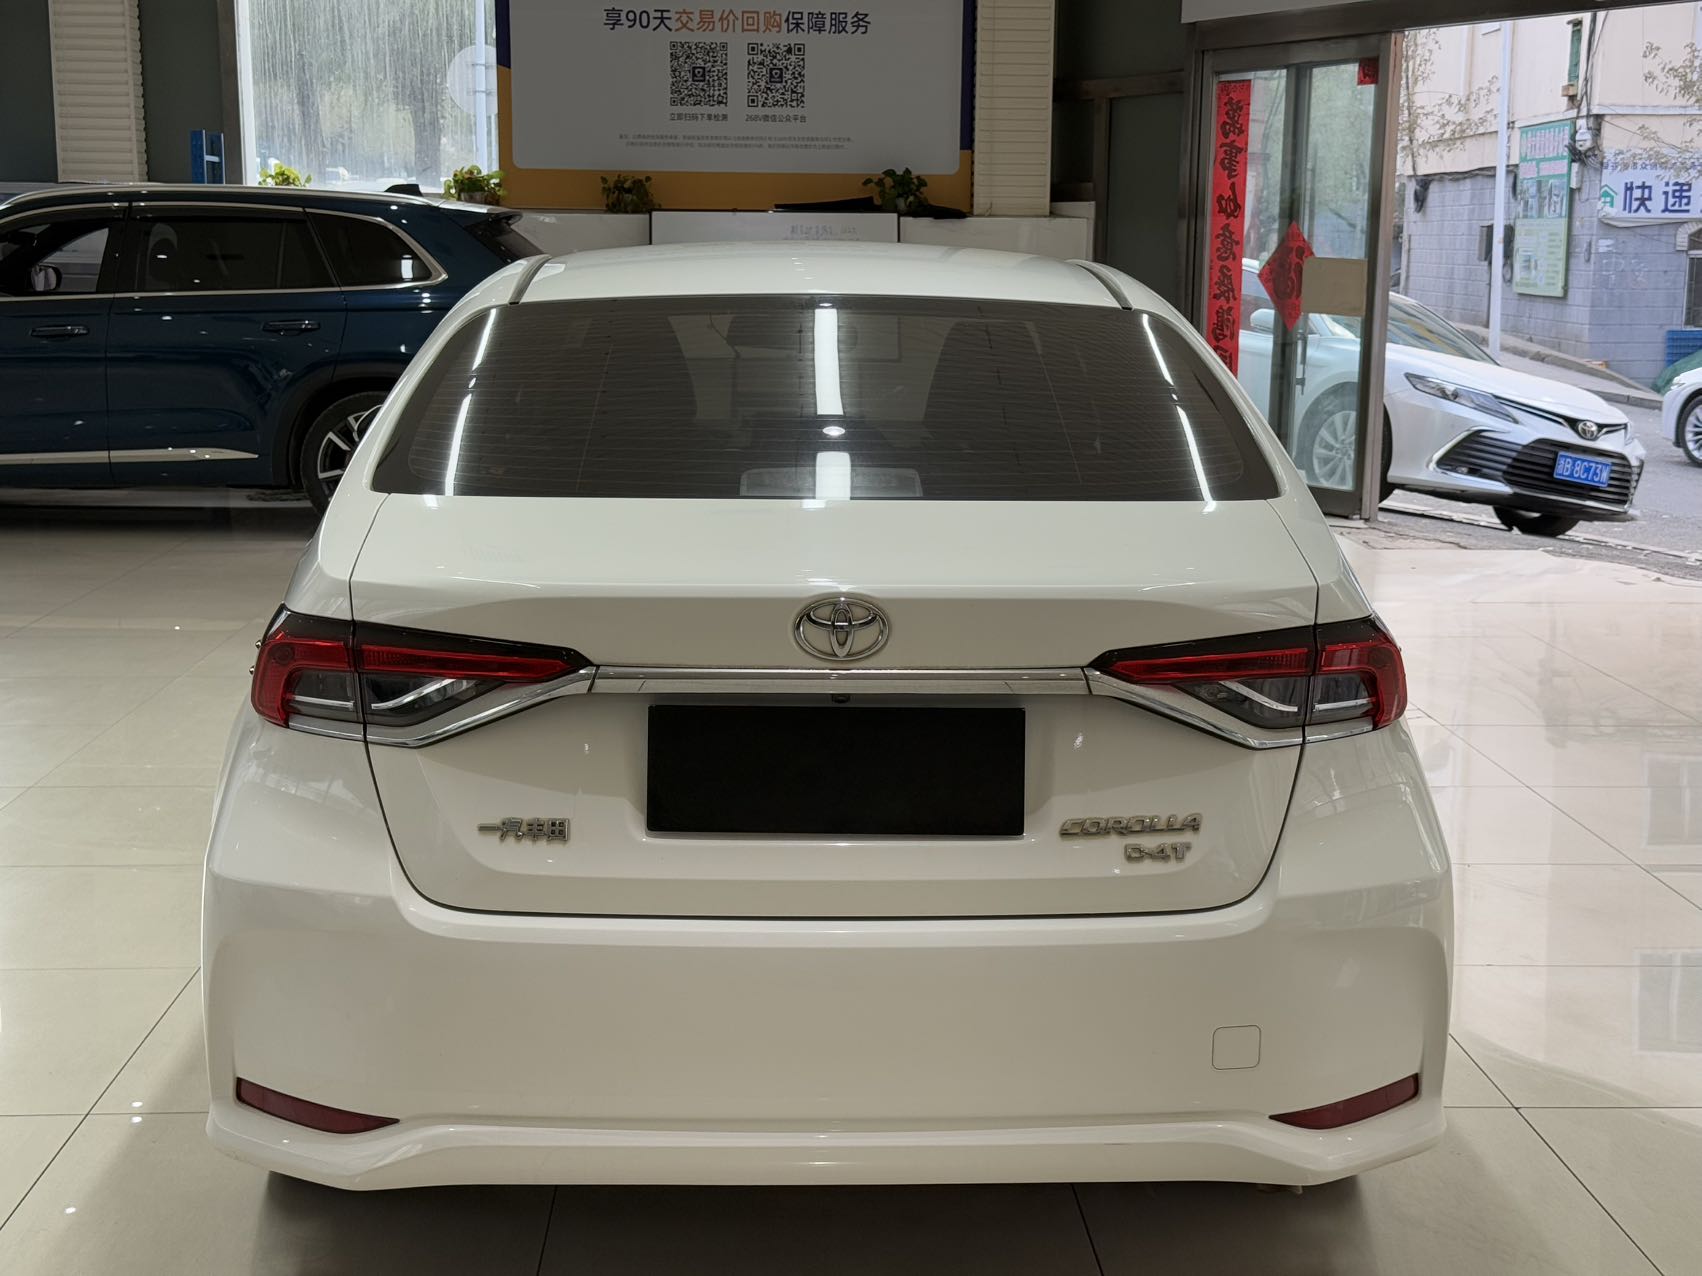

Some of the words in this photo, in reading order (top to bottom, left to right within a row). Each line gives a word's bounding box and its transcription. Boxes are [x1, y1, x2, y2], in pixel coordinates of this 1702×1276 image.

[603, 7, 871, 35] 享90天交易价回购保障服务
[1622, 181, 1702, 213] 快递
[478, 817, 570, 842] 一汽丰田
[1059, 813, 1202, 839] COROLLA
